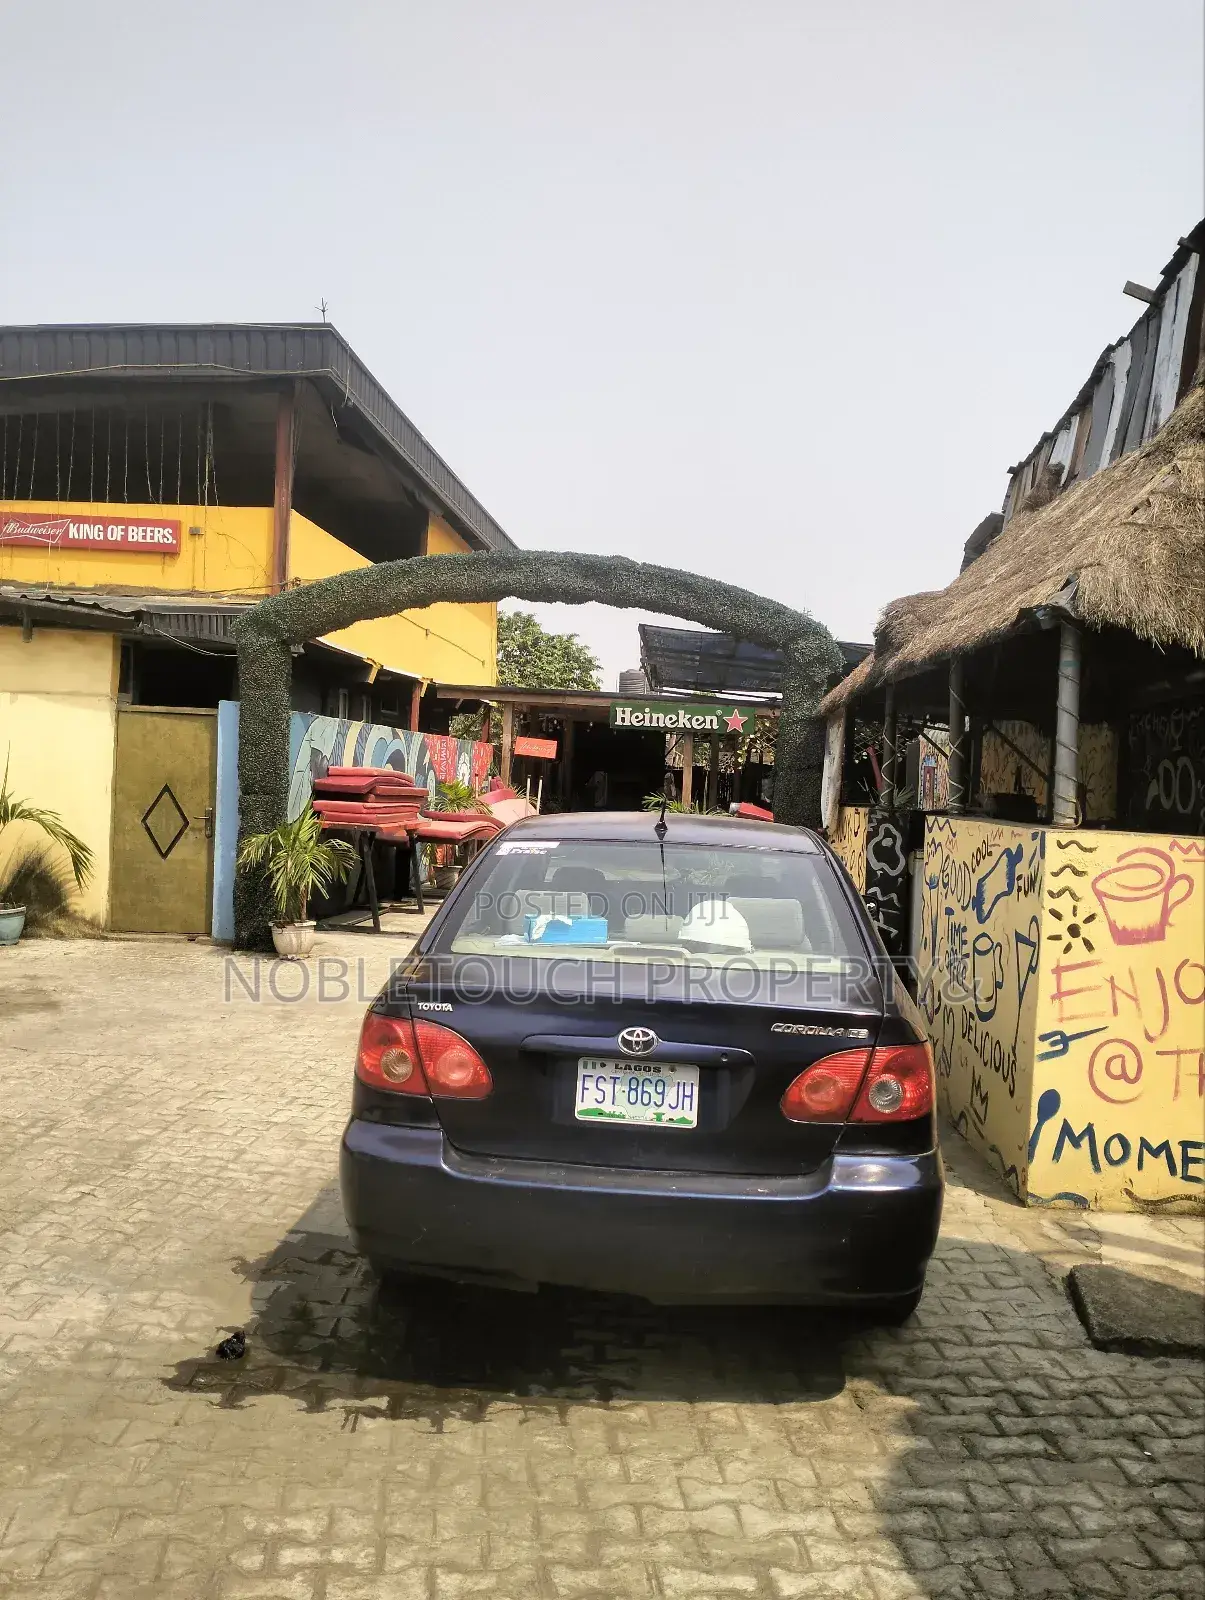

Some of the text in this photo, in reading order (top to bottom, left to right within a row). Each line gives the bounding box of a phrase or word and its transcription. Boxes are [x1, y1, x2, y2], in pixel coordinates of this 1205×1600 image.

[5, 521, 63, 536] Budweiser
[69, 522, 176, 544] KING OF BEERS.
[614, 707, 720, 729] Heineken
[971, 834, 993, 874] COOL
[941, 854, 972, 912] GOOD
[945, 906, 970, 960] TIME
[418, 1002, 453, 1012] TOYOTA
[771, 1023, 844, 1036] COROLLA
[961, 1004, 1018, 1098] DELICIOUS
[614, 1063, 662, 1073] LAGOS
[1088, 1038, 1143, 1104] @
